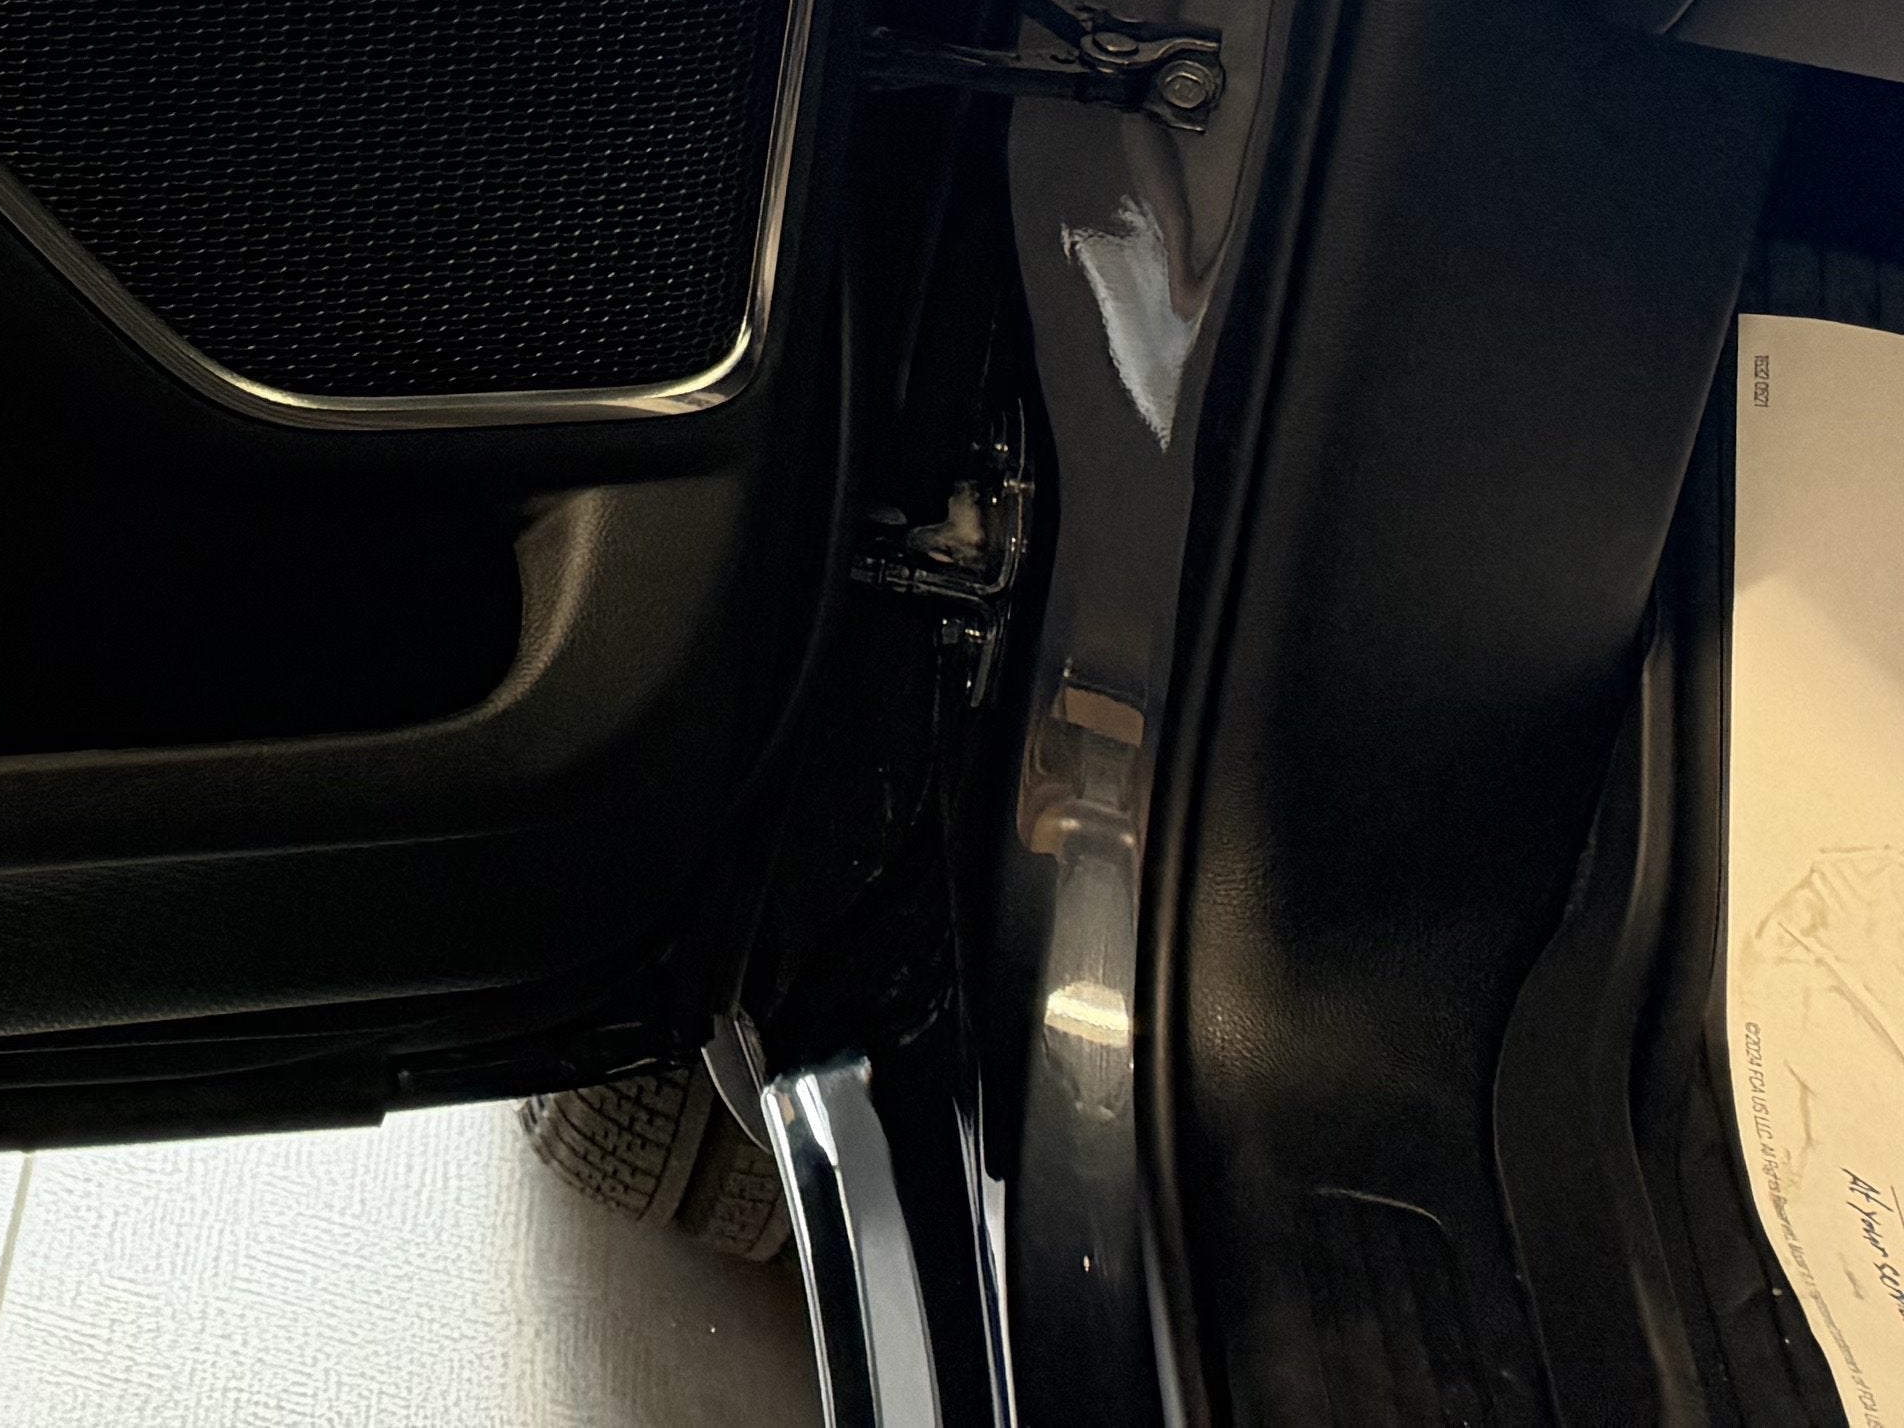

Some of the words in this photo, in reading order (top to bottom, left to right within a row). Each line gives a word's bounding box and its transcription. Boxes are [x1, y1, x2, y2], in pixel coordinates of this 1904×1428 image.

[1748, 1067, 1766, 1094] FCA
[1840, 1167, 1895, 1213] At
[1846, 1201, 1889, 1259] your
